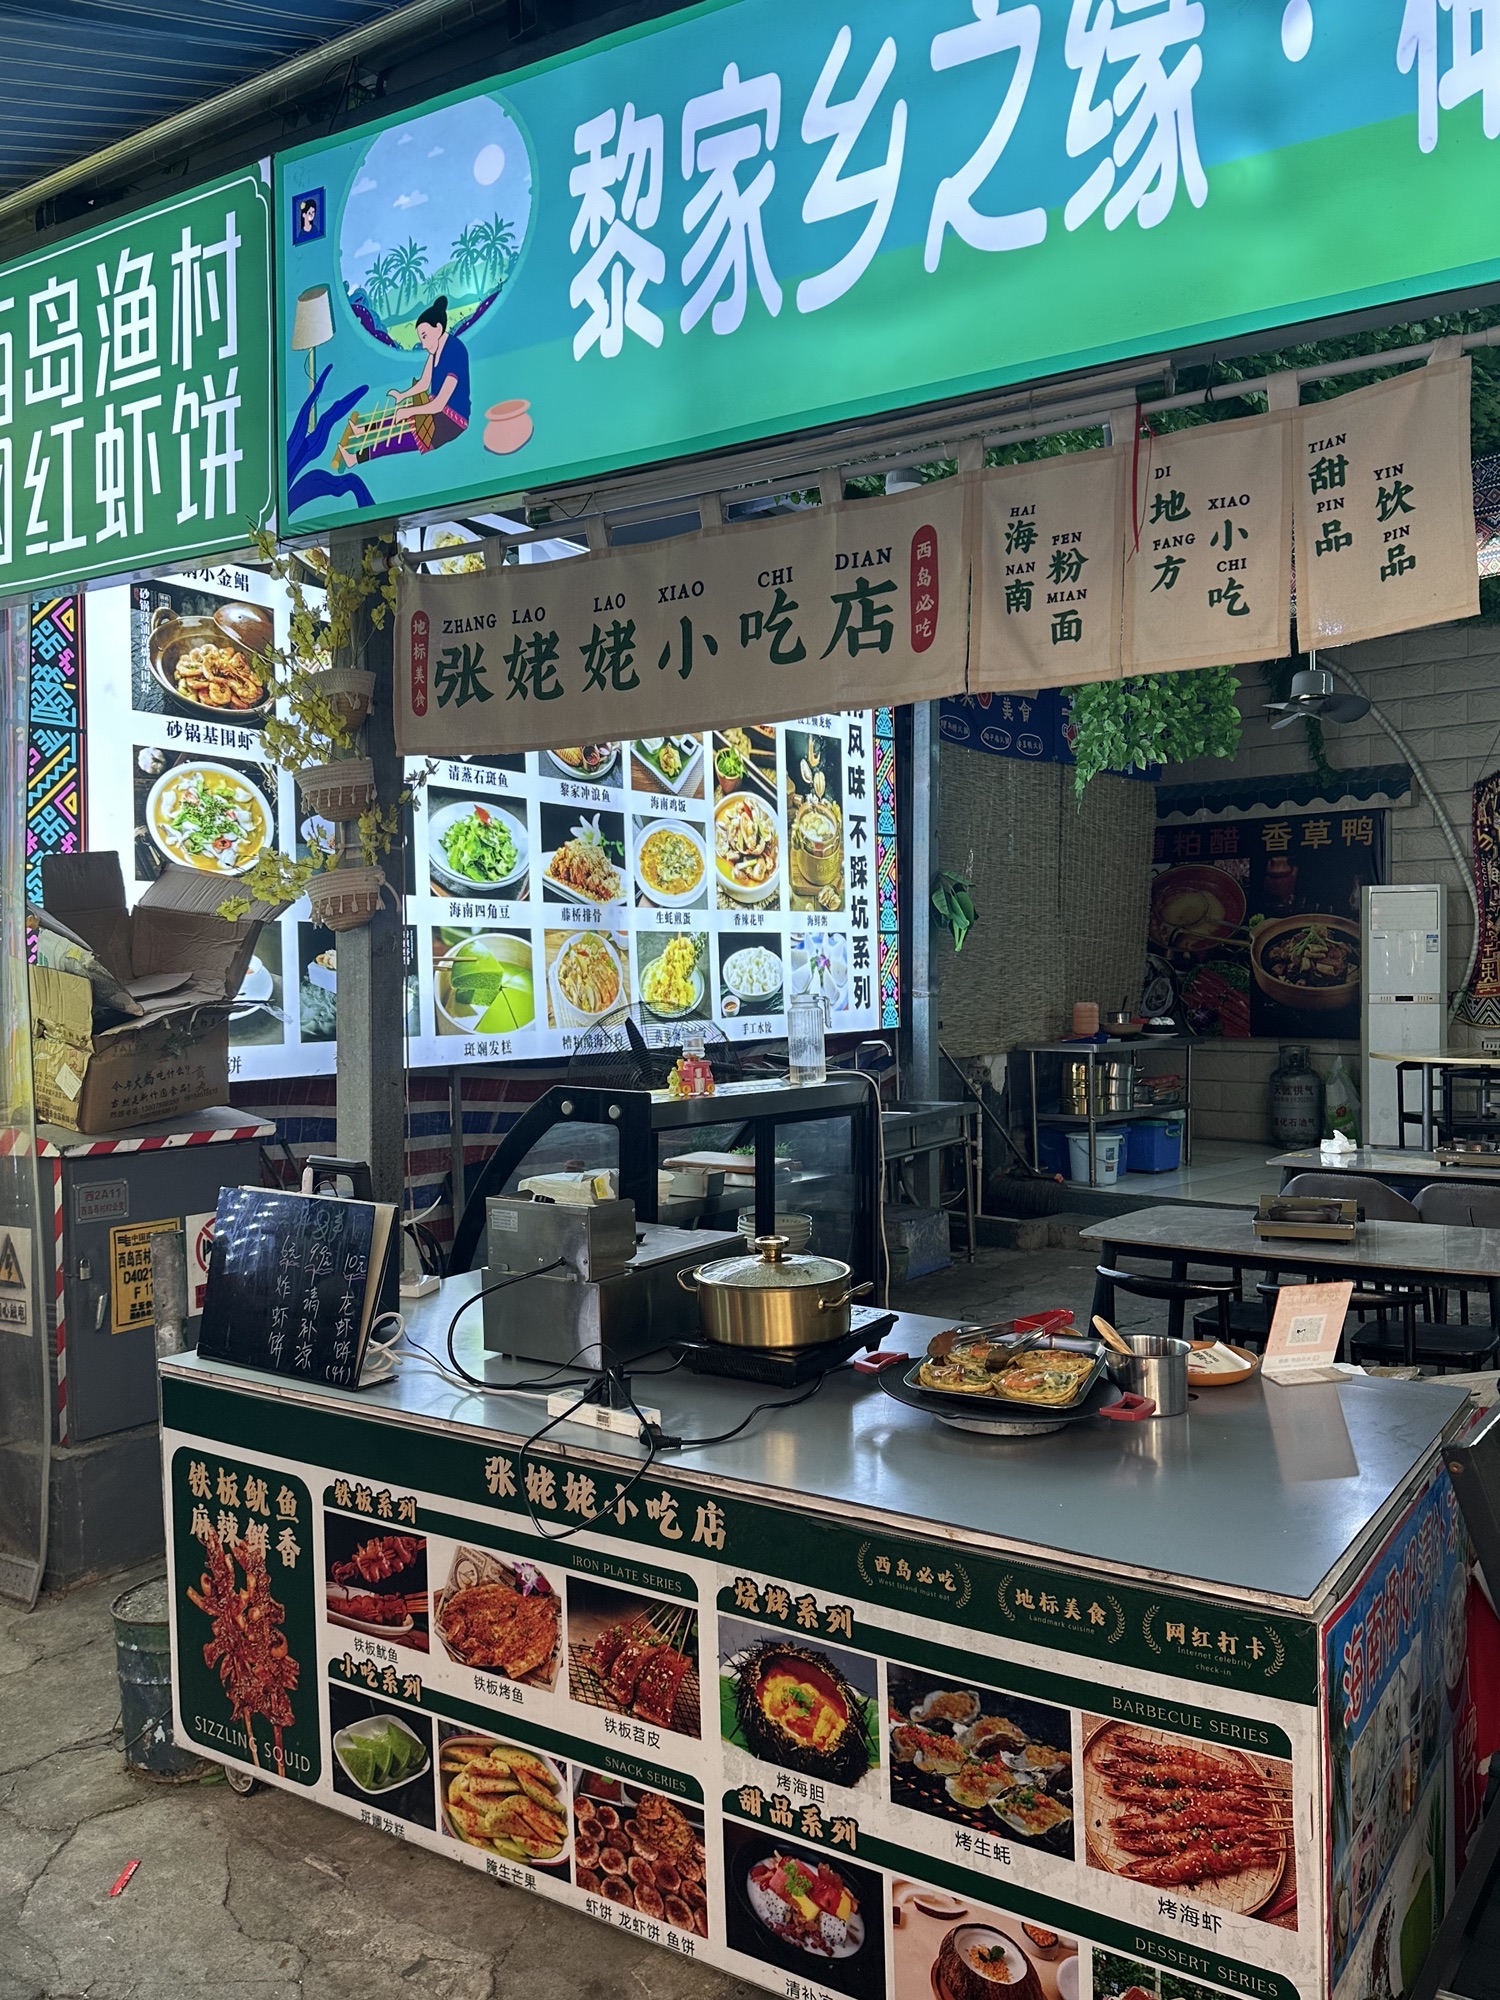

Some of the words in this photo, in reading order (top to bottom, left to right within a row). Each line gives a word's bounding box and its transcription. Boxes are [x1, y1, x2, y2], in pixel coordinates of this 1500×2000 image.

[0, 210, 241, 427] 岛渔村
[1308, 433, 1347, 454] TIAN
[0, 366, 243, 565] 红虾饼
[1154, 466, 1171, 480] DI
[1373, 464, 1405, 481] YIN
[1010, 504, 1037, 518] HAI
[1208, 494, 1251, 510] XIAO
[1317, 497, 1345, 514] PIN
[1051, 532, 1082, 546] FEN
[1153, 533, 1195, 551] FANG
[1383, 525, 1411, 543] PIN
[1005, 562, 1036, 577] NAN
[1216, 558, 1247, 573] CHI
[442, 614, 497, 634] ZHANG
[512, 607, 546, 625] LAO
[594, 593, 626, 614] LAO
[658, 580, 705, 604] XIAO
[757, 566, 793, 588] CHI
[834, 547, 893, 572] DIAN
[914, 540, 935, 638] 西岛必吃
[1046, 589, 1087, 605] MIAN
[434, 577, 898, 709] 张姥姥小吃店
[412, 620, 428, 708] 地标美食
[166, 720, 253, 751] 砂锅基围虾
[448, 764, 509, 788] 清蒸石斑鱼
[560, 782, 611, 803] 黎家冲浪鱼
[650, 795, 686, 812] 海南鸡饭
[1261, 815, 1375, 853] 香草鸭
[449, 902, 510, 919] 海南四角豆
[561, 907, 602, 923] 藤桥排骨
[656, 911, 691, 925] 生蚝煎蛋
[734, 914, 764, 926] 香辣花甲
[742, 1021, 772, 1035] 手工水饺
[0, 1302, 24, 1321] 心触电
[187, 1460, 300, 1524] 铁板鱿鱼
[333, 1479, 417, 1525] 铁板系列
[484, 1456, 727, 1550] 张姥姥小吃店
[189, 1504, 301, 1569] 麻辣鲜香
[572, 1555, 600, 1572] IRON
[603, 1562, 639, 1582] PLATE
[642, 1573, 682, 1593] SERIES
[874, 1555, 958, 1592] 西岛必吃
[878, 1578, 895, 1587] West
[919, 1587, 937, 1597] must
[734, 1579, 854, 1639] 烧烤系列
[1015, 1588, 1107, 1628] 地标美食
[1028, 1613, 1066, 1630] Landmark
[1067, 1623, 1095, 1636] cuisine
[353, 1636, 399, 1664] 铁板鱿鱼
[1165, 1621, 1266, 1660] 网红打卡
[1177, 1646, 1215, 1662] Internet
[1216, 1654, 1252, 1669] celebrity
[1195, 1663, 1232, 1676] check-in
[339, 1653, 423, 1703] 小吃系列
[473, 1675, 524, 1704] 铁板烤鱼
[1112, 1696, 1203, 1730] BARBECUE
[1209, 1719, 1269, 1745] SERIES
[194, 1715, 259, 1753] SIZZLING
[263, 1742, 311, 1772] SQUID
[604, 1755, 643, 1778] SNACK
[646, 1767, 687, 1793] SERIES
[776, 1771, 825, 1803] 烤海胆
[738, 1786, 858, 1851] 甜品系列
[955, 1830, 1011, 1865] 烤生蚝
[486, 1858, 537, 1891] 腌生芒果
[586, 1898, 613, 1922] 虾饼
[619, 1911, 661, 1941] 龙虾饼
[666, 1930, 695, 1956] 鱼饼
[1158, 1896, 1222, 1934] 烤海虾
[1134, 1936, 1210, 1973] DESSERT
[1217, 1964, 1278, 1997] SERIES
